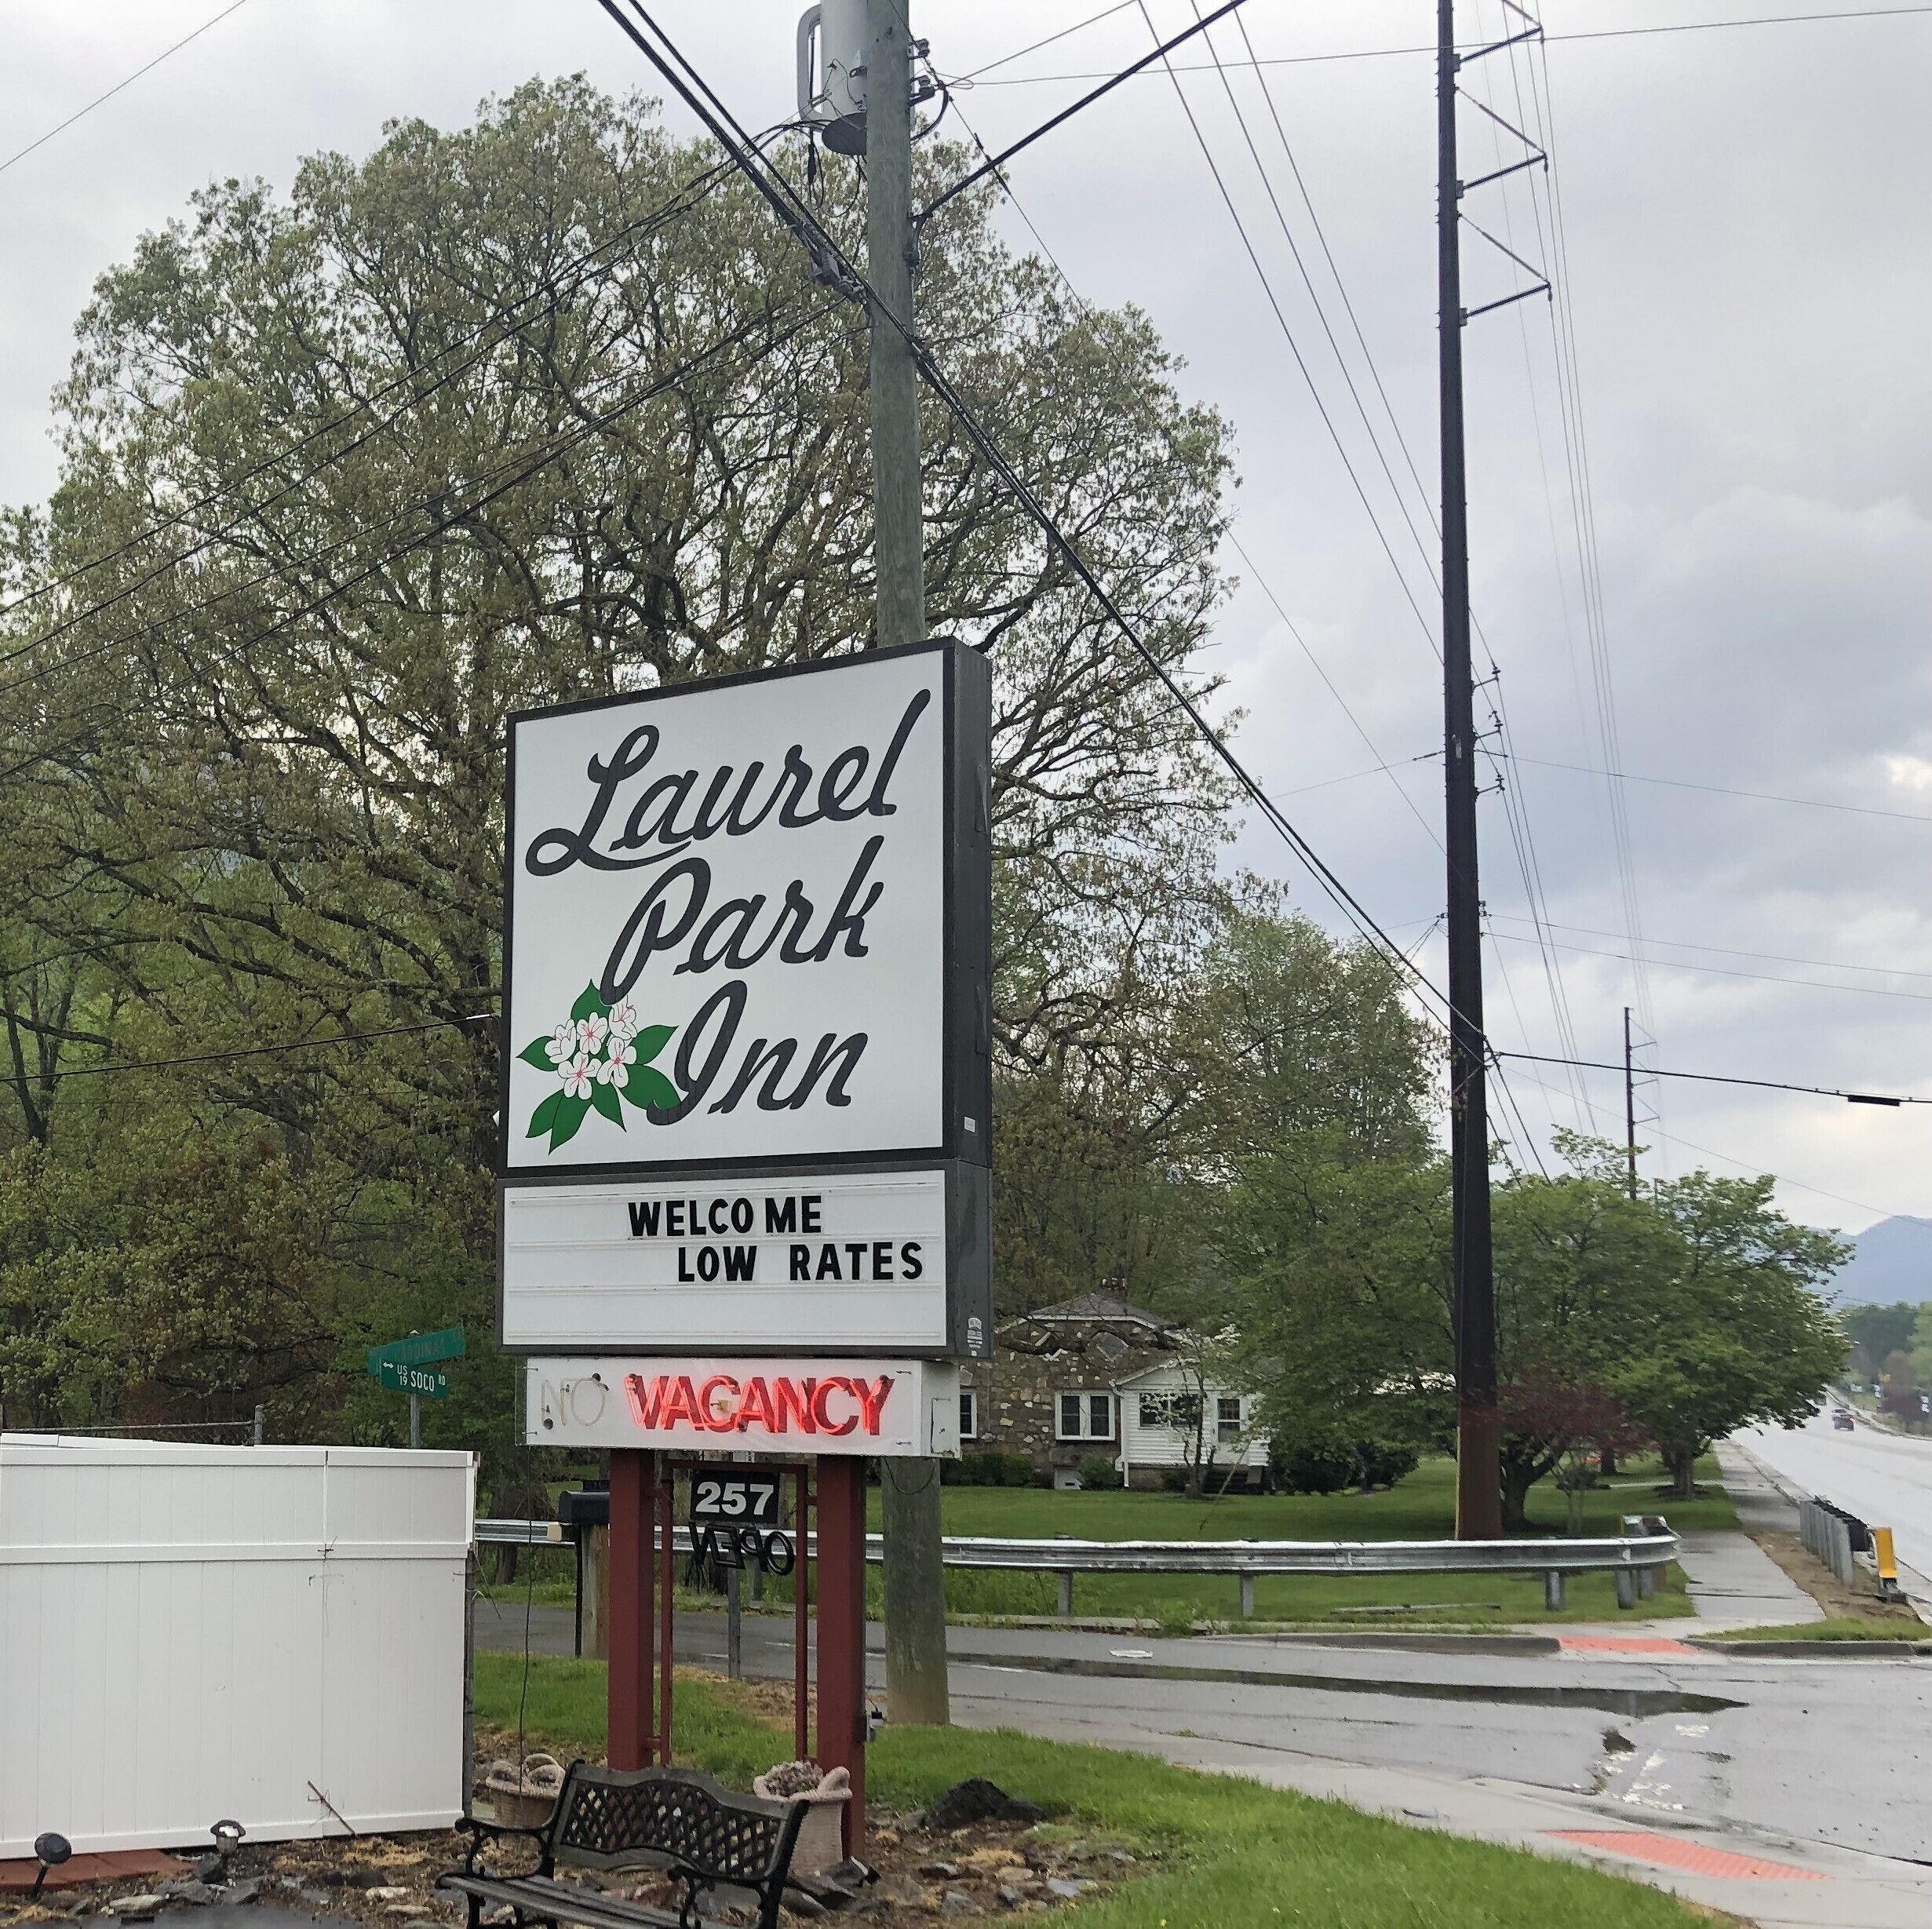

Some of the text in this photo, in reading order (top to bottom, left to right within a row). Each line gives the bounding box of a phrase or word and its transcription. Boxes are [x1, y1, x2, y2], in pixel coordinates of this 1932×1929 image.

[526, 688, 931, 877] Laurel
[600, 835, 884, 1006] Park
[646, 979, 868, 1126] Inn
[678, 1242, 923, 1282] LOW RATES
[397, 1364, 408, 1377] US
[399, 1375, 408, 1386] 19
[410, 1370, 446, 1392] SOCO RD
[541, 1375, 895, 1436] NO VACANCY
[695, 1481, 775, 1515] 257
